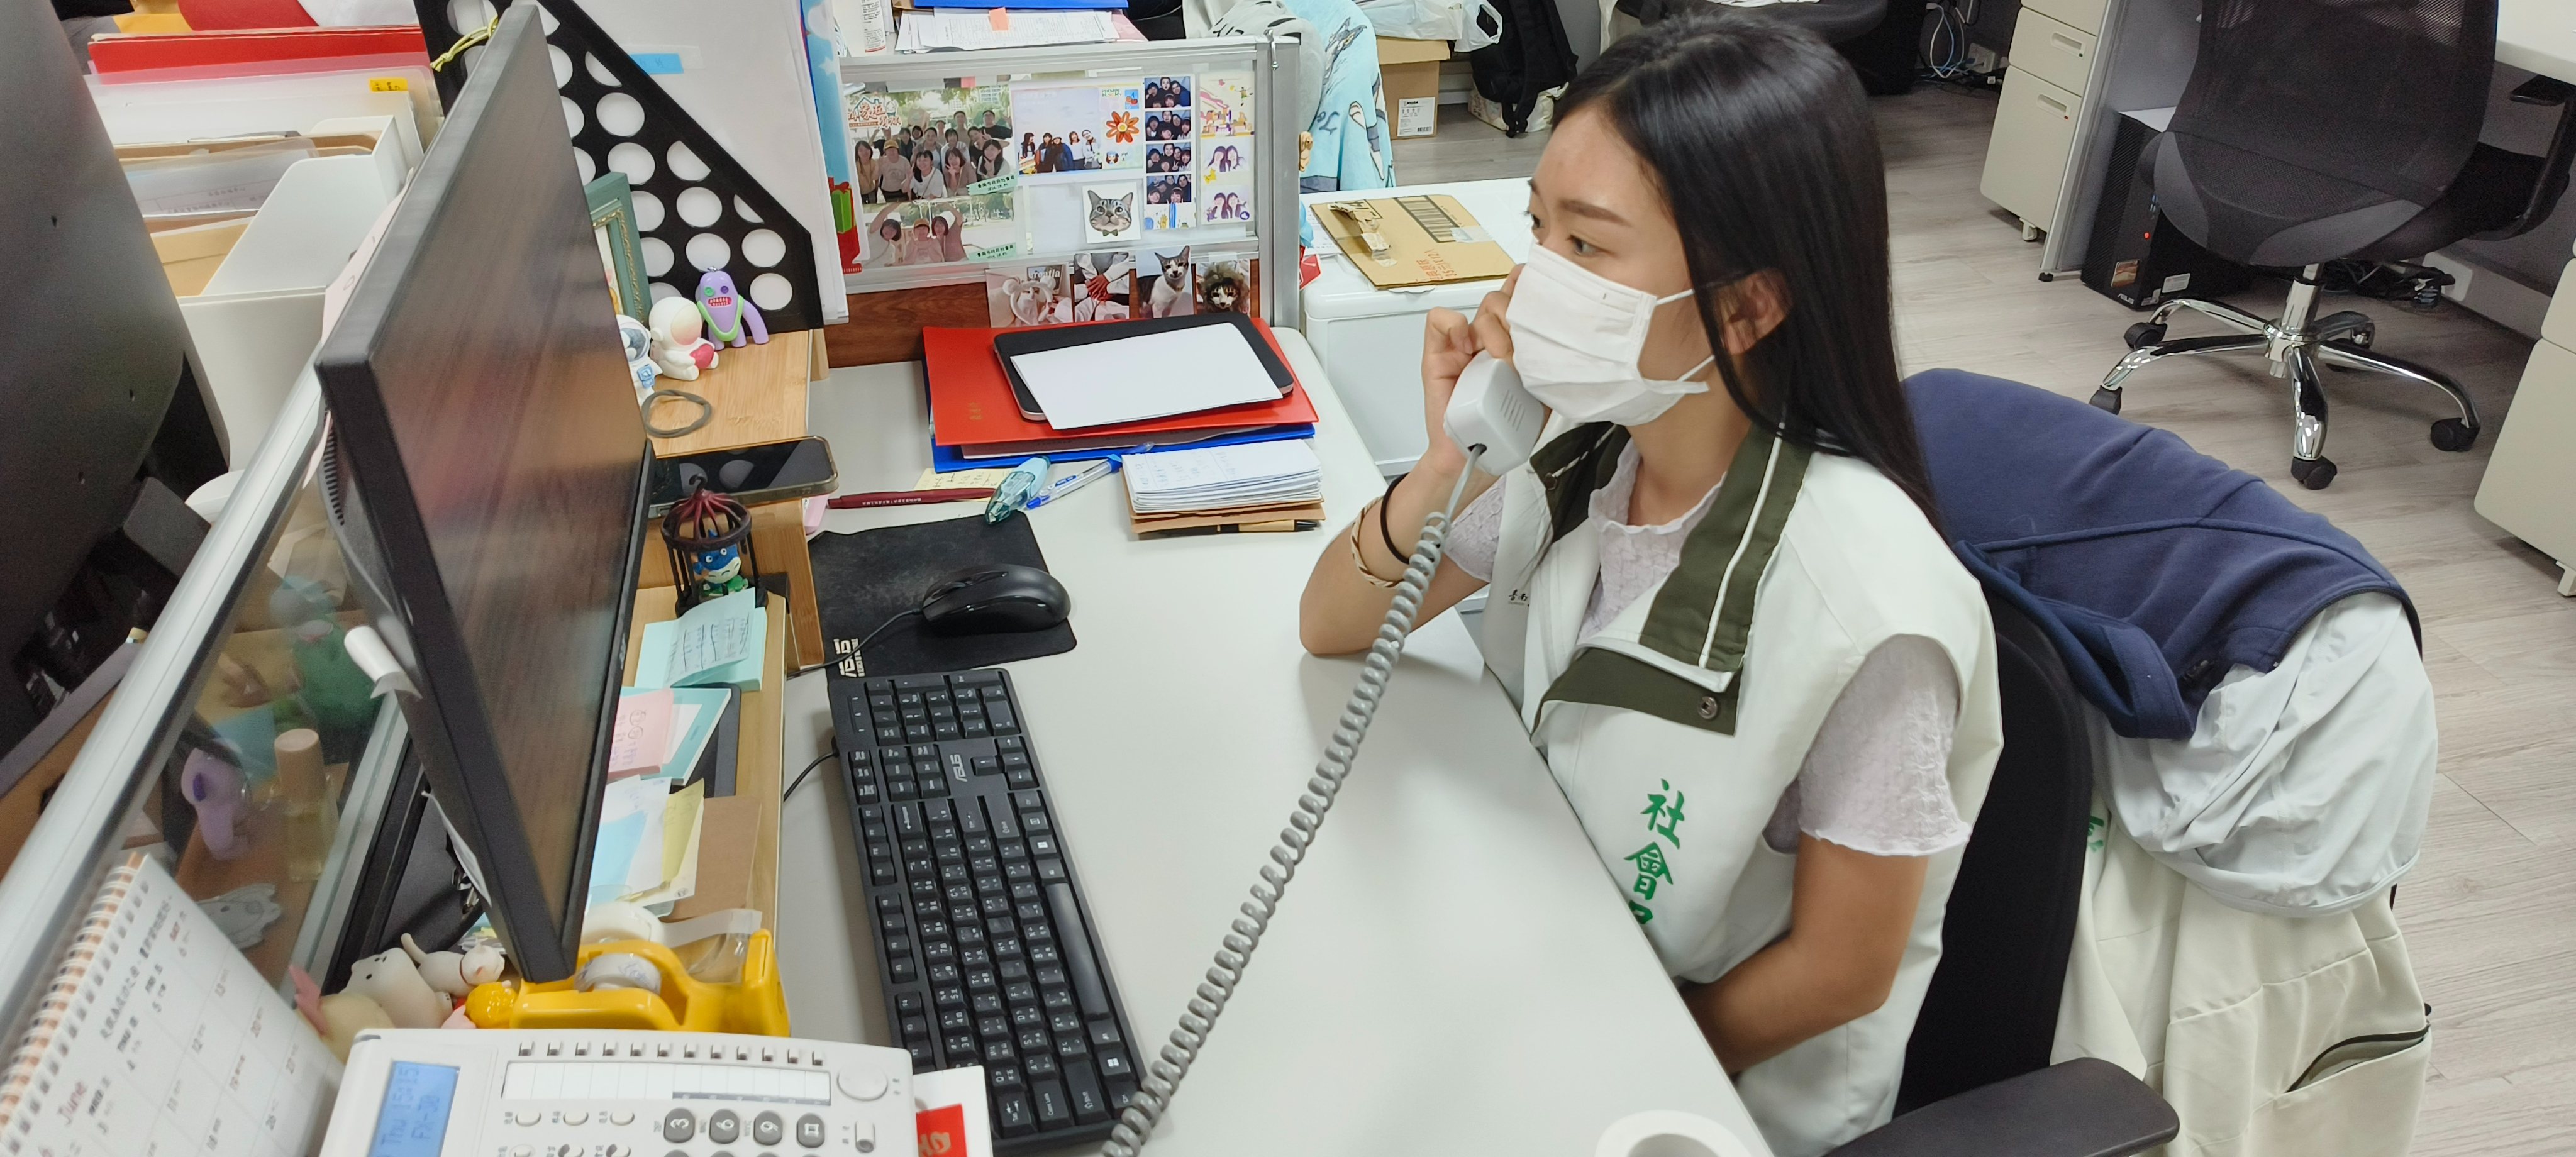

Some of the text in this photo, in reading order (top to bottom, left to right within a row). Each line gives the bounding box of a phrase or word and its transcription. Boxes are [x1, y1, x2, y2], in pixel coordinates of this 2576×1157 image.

[950, 755, 967, 782] ASUS
[57, 1082, 87, 1125] June
[670, 1118, 689, 1129] 3
[716, 1119, 735, 1130] 6
[760, 1121, 779, 1132] 9
